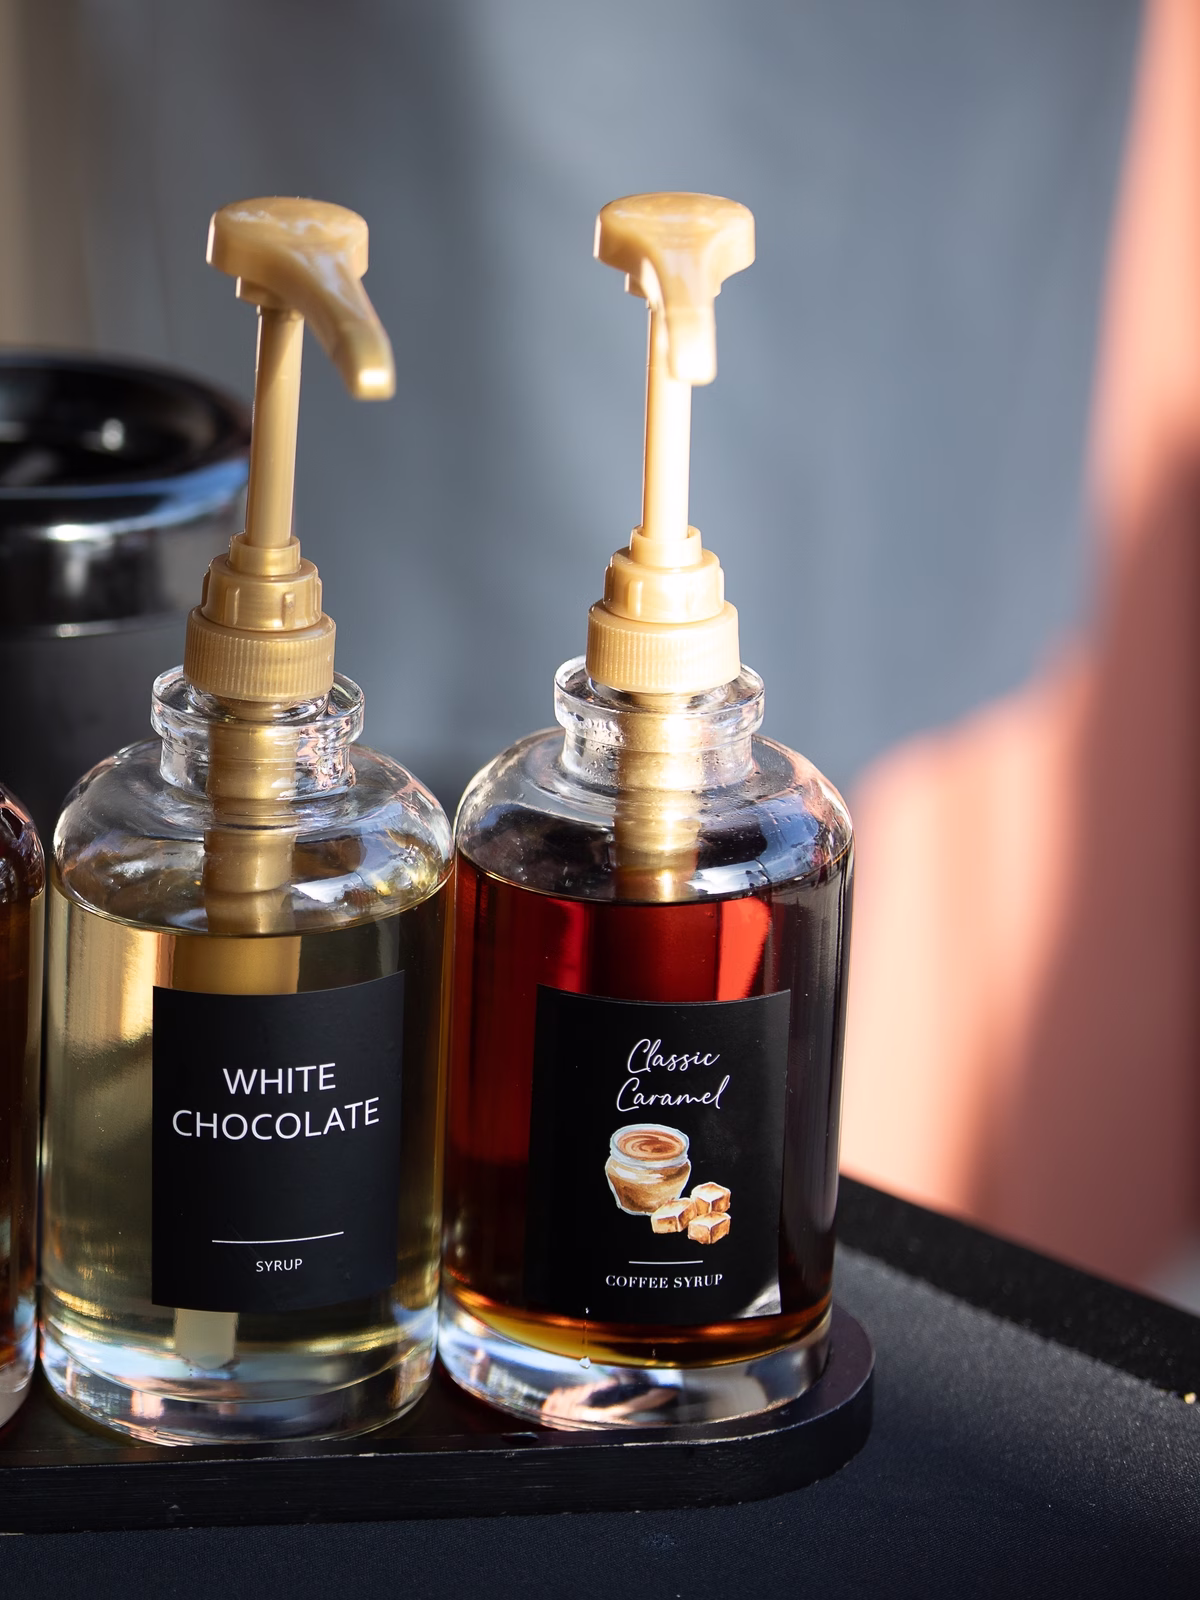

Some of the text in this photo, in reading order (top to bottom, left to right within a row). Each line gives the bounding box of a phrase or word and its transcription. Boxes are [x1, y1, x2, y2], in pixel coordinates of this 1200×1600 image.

[627, 1038, 721, 1074] Classic
[222, 1062, 337, 1095] WHITE
[615, 1074, 731, 1113] Caramel
[172, 1096, 380, 1141] CHOCOLATE
[255, 1258, 303, 1273] SYRUP
[605, 1273, 723, 1289] COFFEE SYRUP
